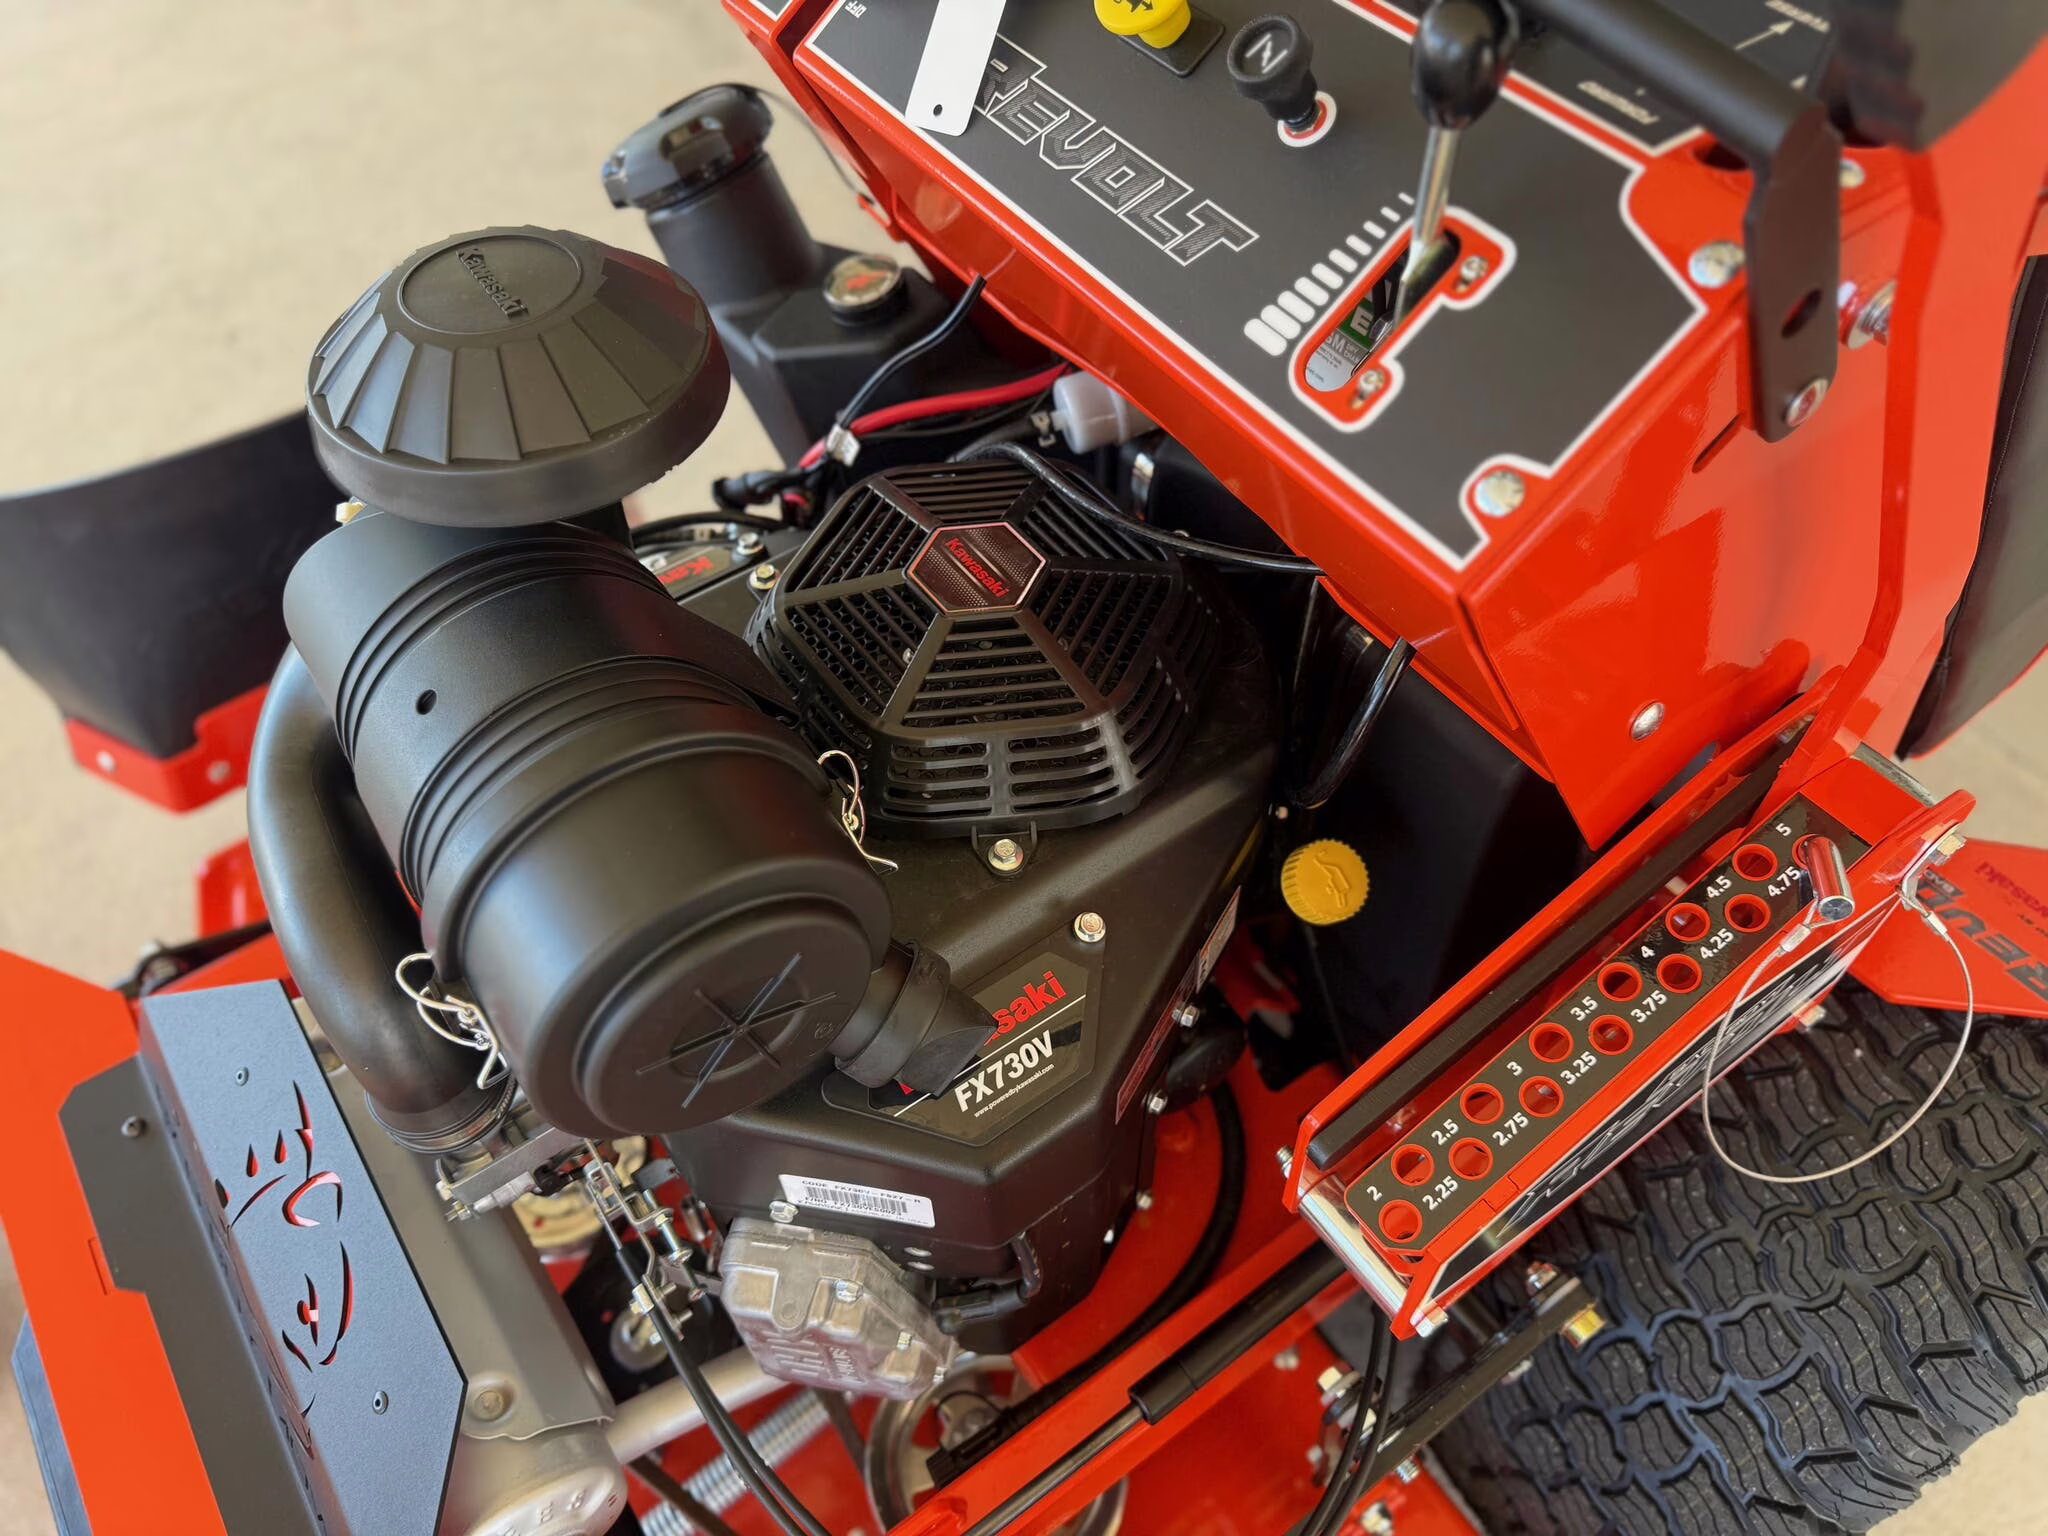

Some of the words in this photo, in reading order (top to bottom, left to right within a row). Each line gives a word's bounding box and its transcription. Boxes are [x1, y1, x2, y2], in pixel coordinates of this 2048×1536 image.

[456, 246, 529, 319] Kawasaki
[945, 537, 1010, 598] Kawasaki
[1775, 822, 1792, 837] 5
[1706, 875, 1732, 898] 4.5
[1767, 866, 1801, 897] 4.75
[1640, 944, 1656, 959] 4
[1700, 928, 1734, 959] 4.25
[984, 971, 1067, 1046] saki
[1570, 995, 1598, 1021] 3.5
[1630, 990, 1667, 1023] 3.75
[954, 1030, 1053, 1113] FX730V
[1506, 1061, 1523, 1076] 3
[1560, 1051, 1597, 1085] 3.25
[974, 1063, 1055, 1119] www.poweredbykawasaki.com
[1431, 1118, 1459, 1146] 2.5
[1492, 1112, 1529, 1146] 2.75
[1366, 1185, 1383, 1201] 2
[1422, 1175, 1458, 1210] 2.25
